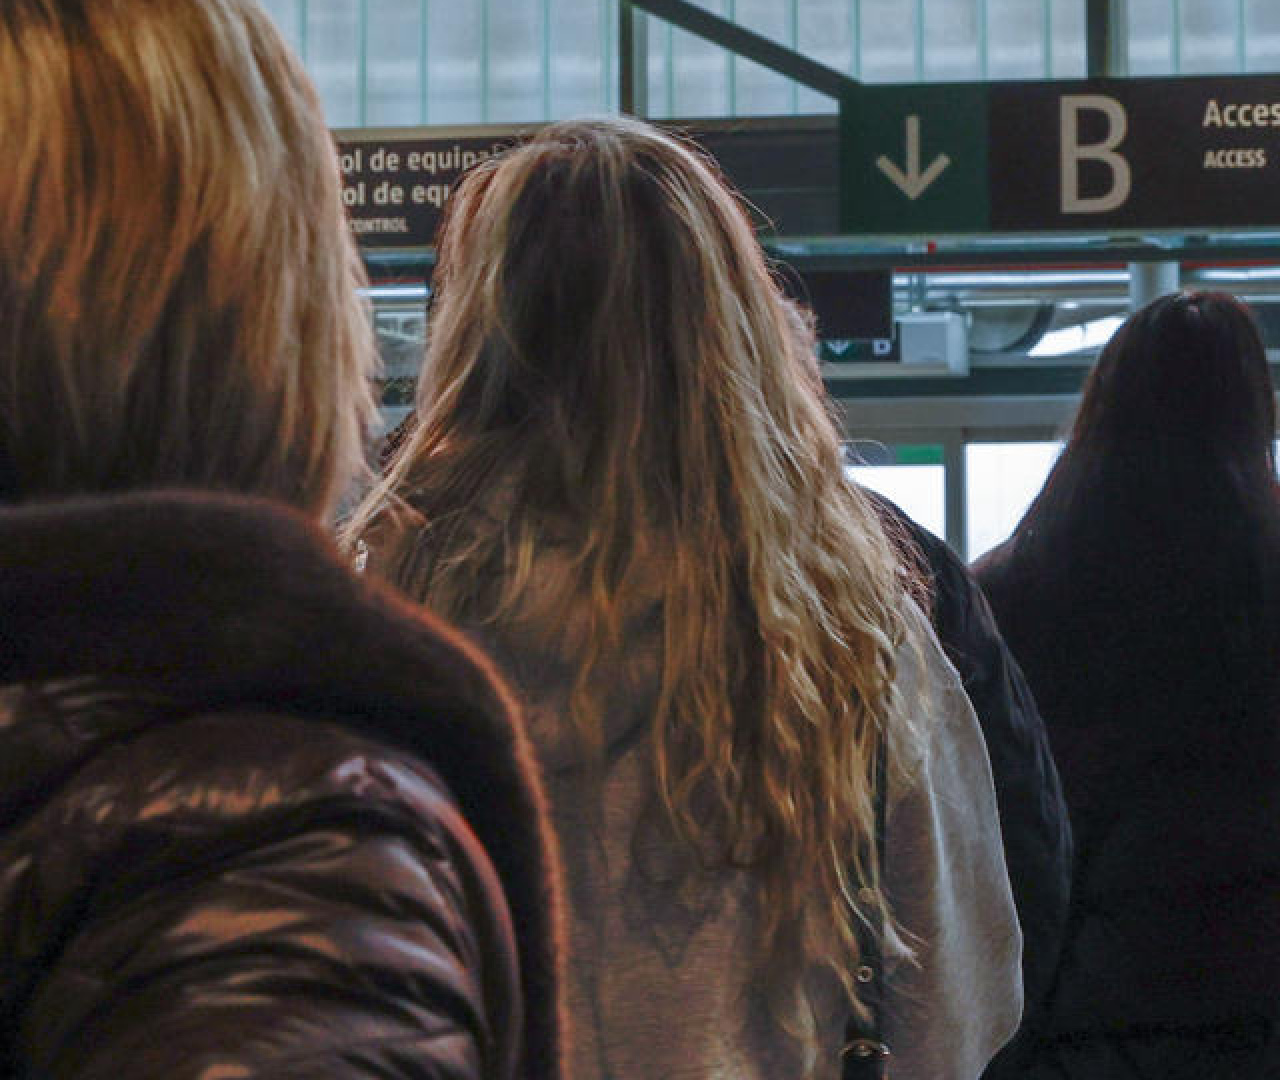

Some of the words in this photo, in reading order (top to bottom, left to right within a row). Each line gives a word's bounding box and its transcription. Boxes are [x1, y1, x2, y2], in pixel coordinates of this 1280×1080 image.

[370, 147, 401, 172] de
[1060, 95, 1131, 213] B
[1204, 149, 1266, 168] ACCESS
[373, 182, 405, 206] de
